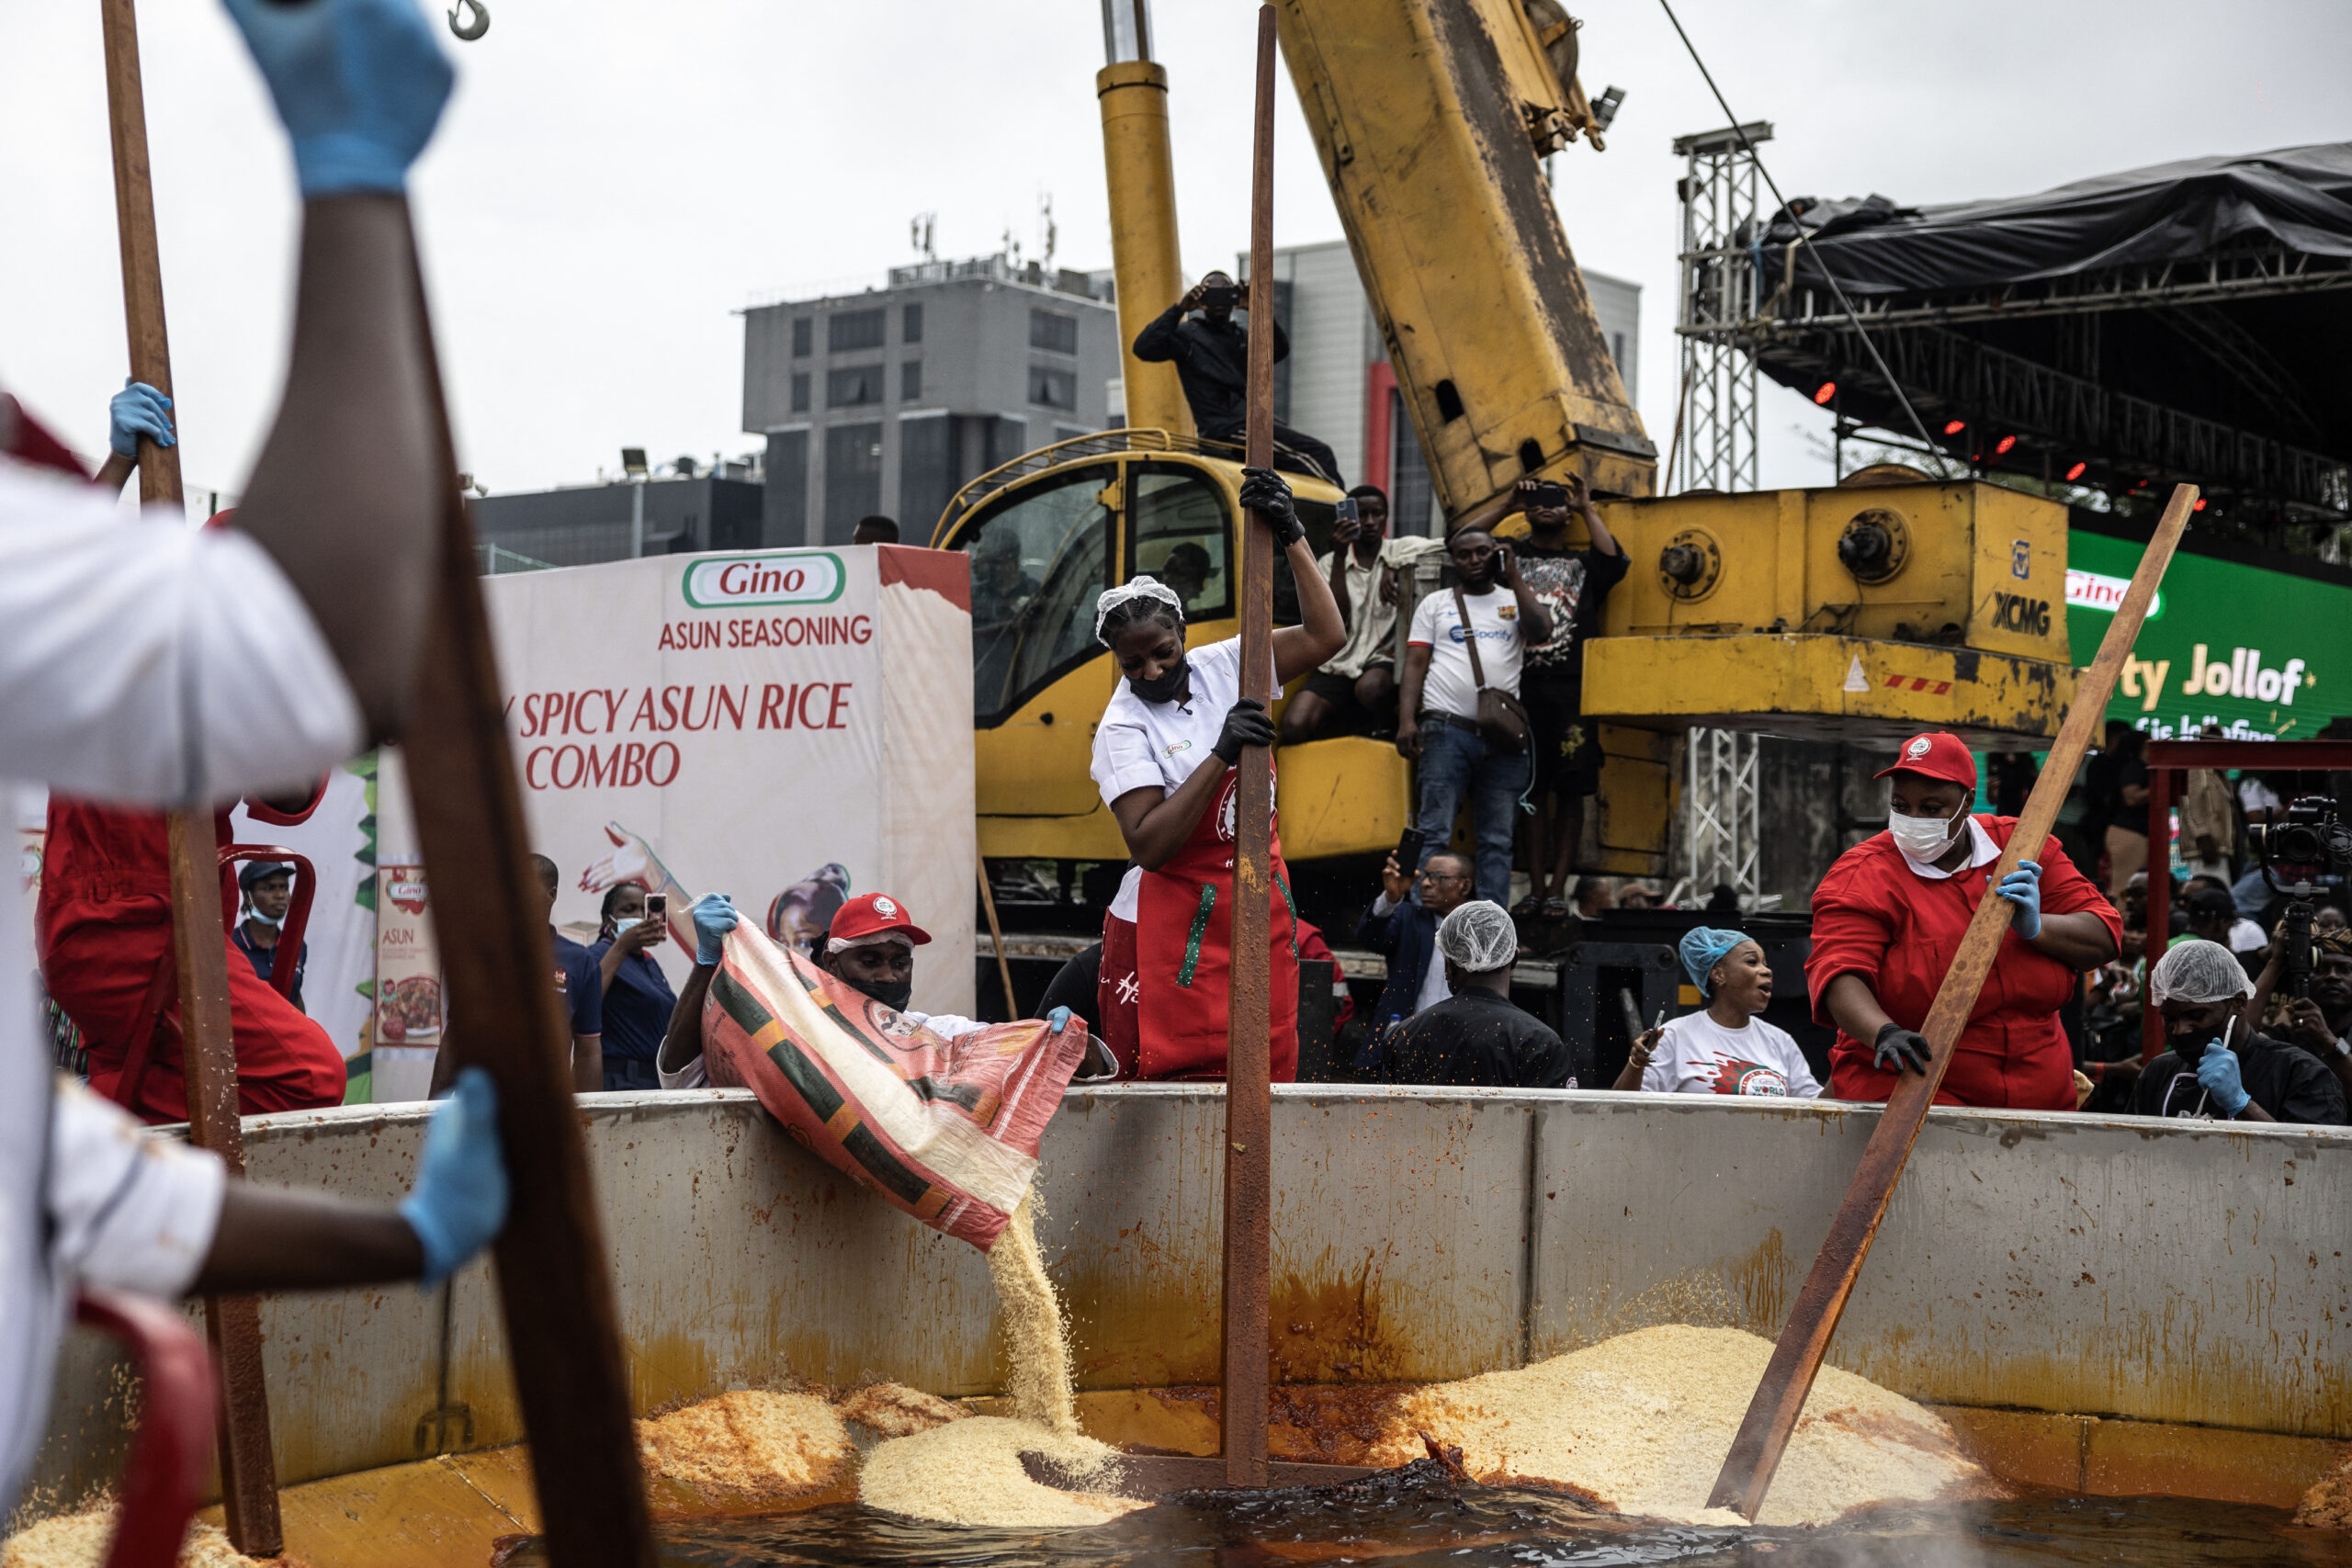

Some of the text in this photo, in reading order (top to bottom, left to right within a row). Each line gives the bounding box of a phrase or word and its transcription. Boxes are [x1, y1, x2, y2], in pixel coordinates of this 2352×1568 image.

[719, 562, 805, 595] Gino
[659, 615, 873, 651] ASUN SEASONING
[1992, 591, 2051, 637] XCMG
[2182, 643, 2305, 706] Jollof
[520, 688, 629, 738] SPICY
[629, 684, 749, 732] ASUN
[757, 682, 853, 730] RICE
[526, 741, 681, 791] COMBO
[382, 928, 413, 945] ASUN
